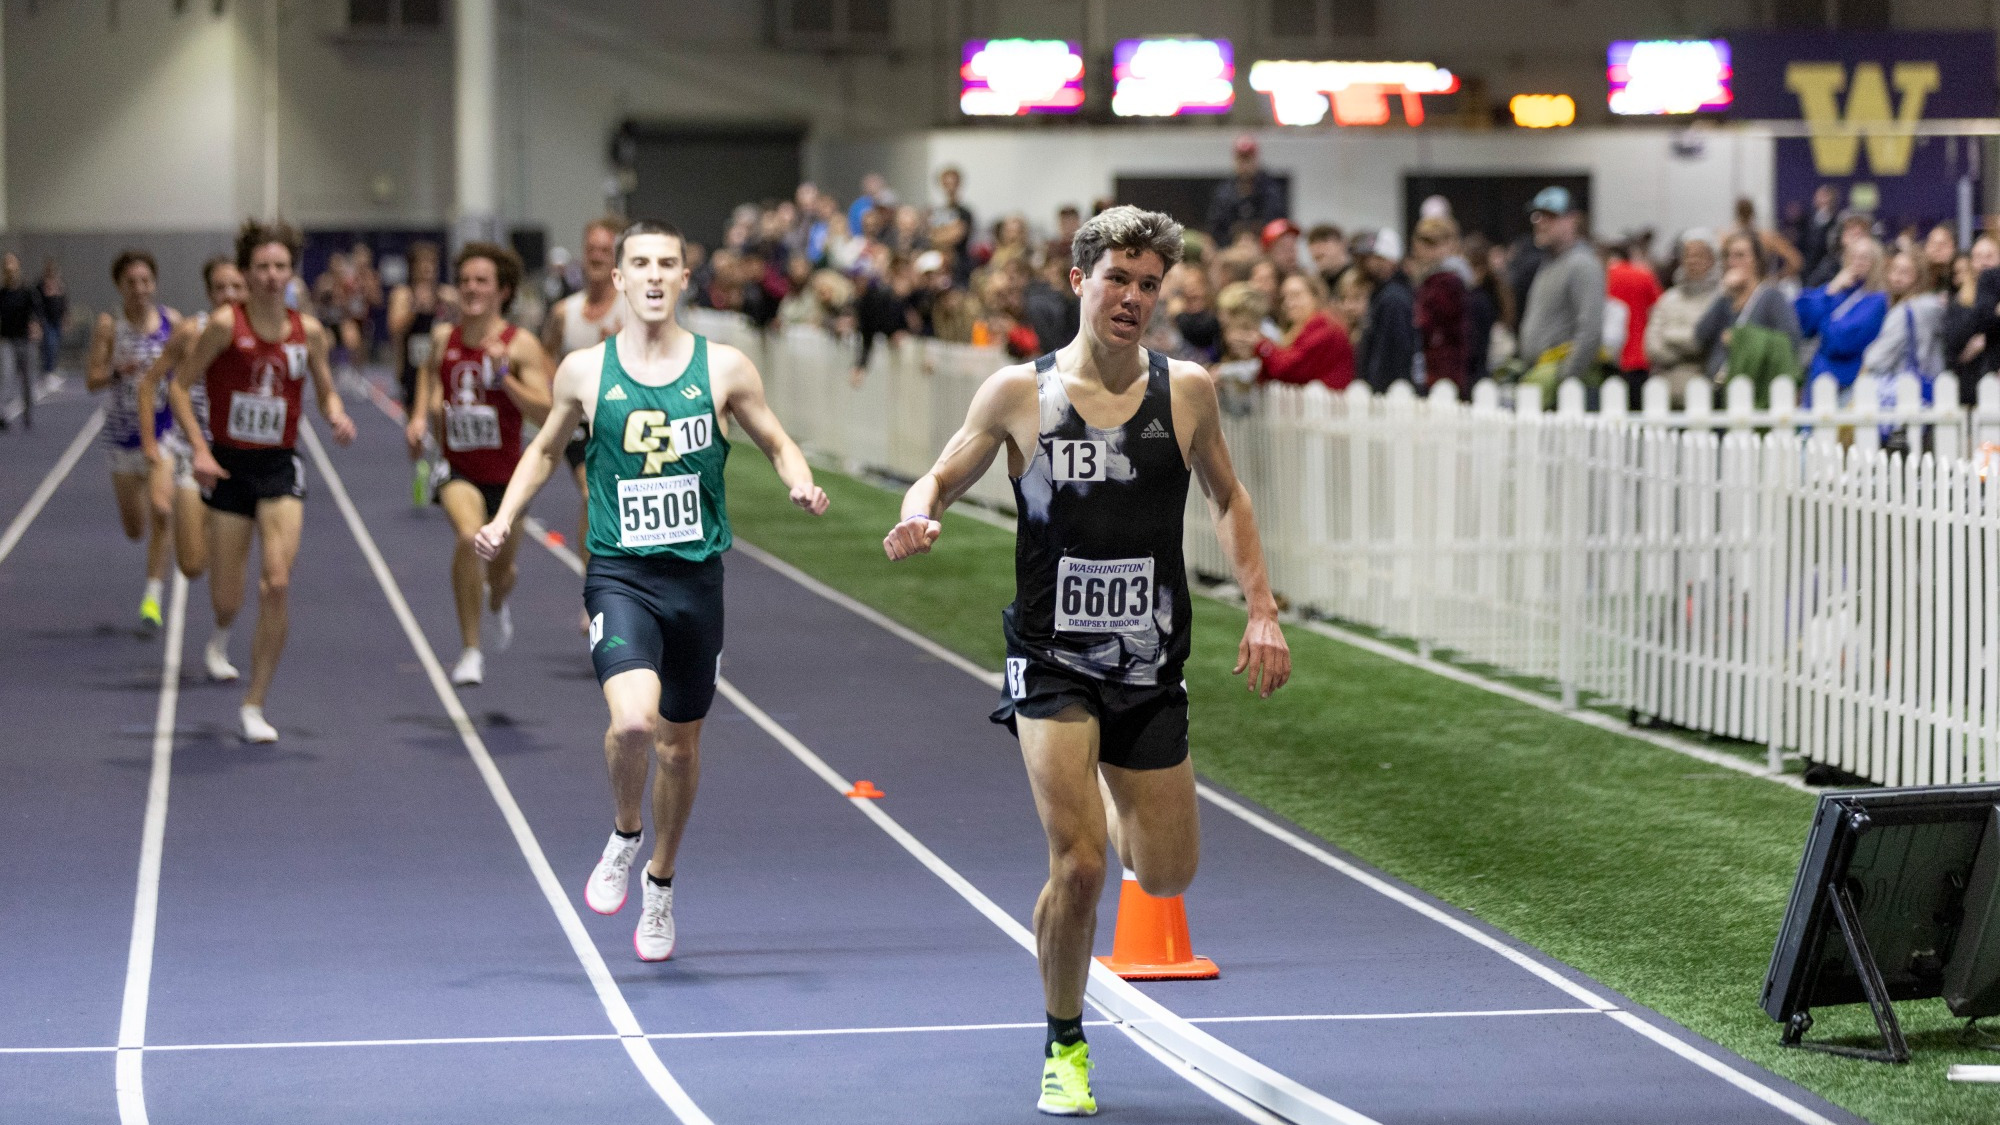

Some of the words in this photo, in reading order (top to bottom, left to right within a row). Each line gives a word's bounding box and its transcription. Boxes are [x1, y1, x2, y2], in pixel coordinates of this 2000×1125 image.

[1785, 61, 1940, 176] W
[680, 418, 707, 450] 10
[1141, 430, 1170, 439] adidas
[1061, 442, 1097, 479] 13
[623, 477, 695, 493] WASHINGTON
[622, 490, 699, 532] 5509
[630, 533, 667, 542] DEMPSEY
[668, 528, 698, 539] INDOOR
[1068, 562, 1146, 574] WASHINGTON
[1061, 575, 1149, 618] 6603
[1068, 619, 1108, 628] DEMPSEY
[1109, 619, 1140, 628] INDOOR
